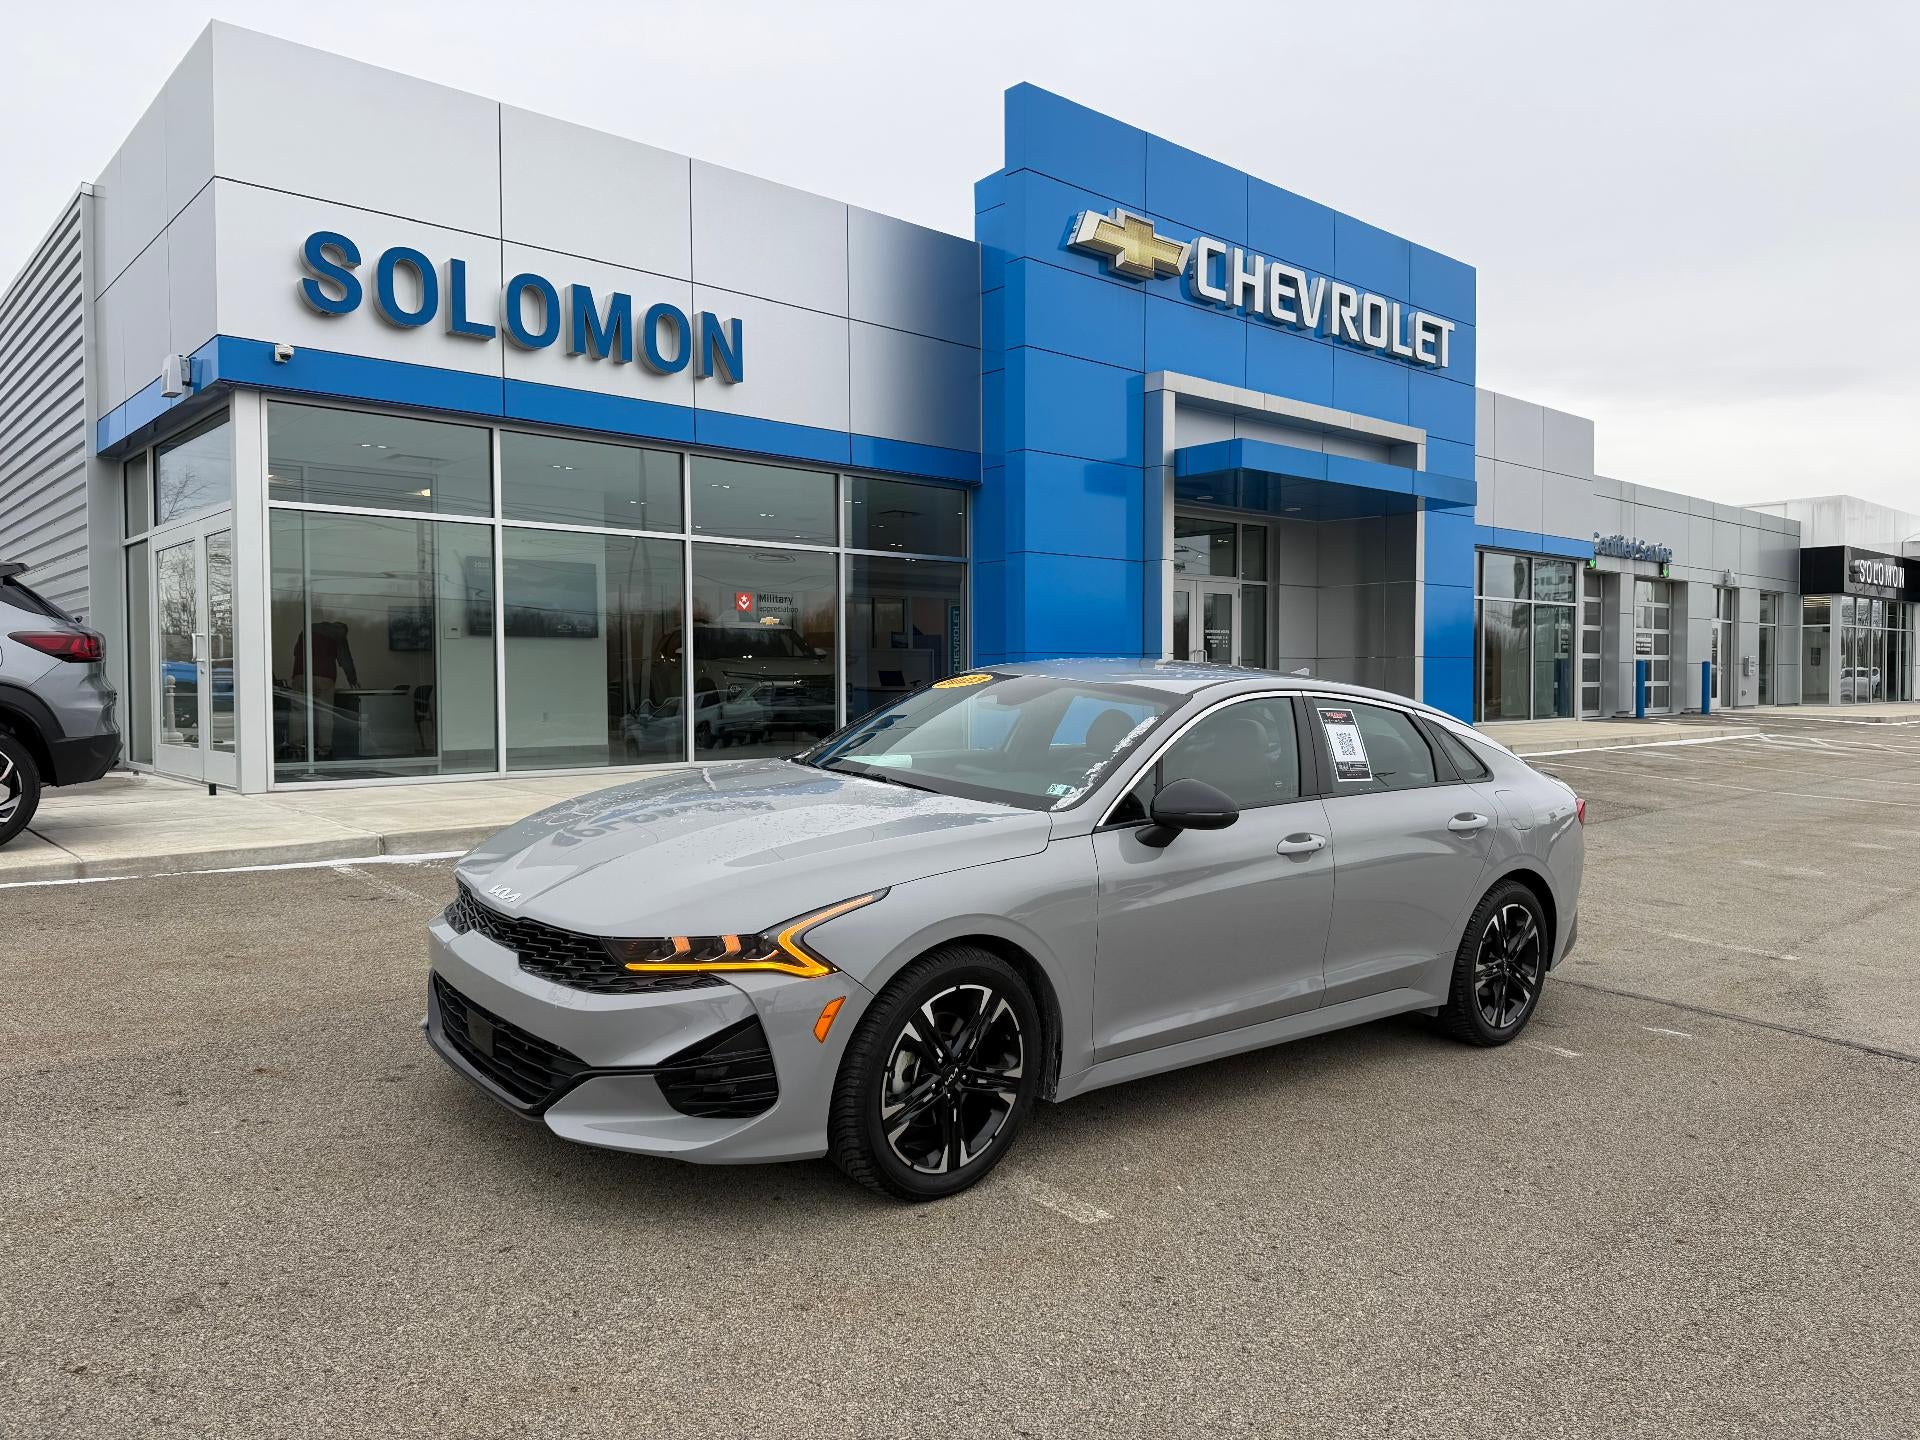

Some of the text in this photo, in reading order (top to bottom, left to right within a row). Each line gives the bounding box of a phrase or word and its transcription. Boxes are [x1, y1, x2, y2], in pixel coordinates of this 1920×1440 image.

[298, 231, 743, 384] SOLOMON
[1192, 236, 1455, 368] CHEVROLET
[1636, 539, 1673, 563] Service
[1858, 559, 1905, 589] SOLOMON
[759, 593, 793, 606] Military
